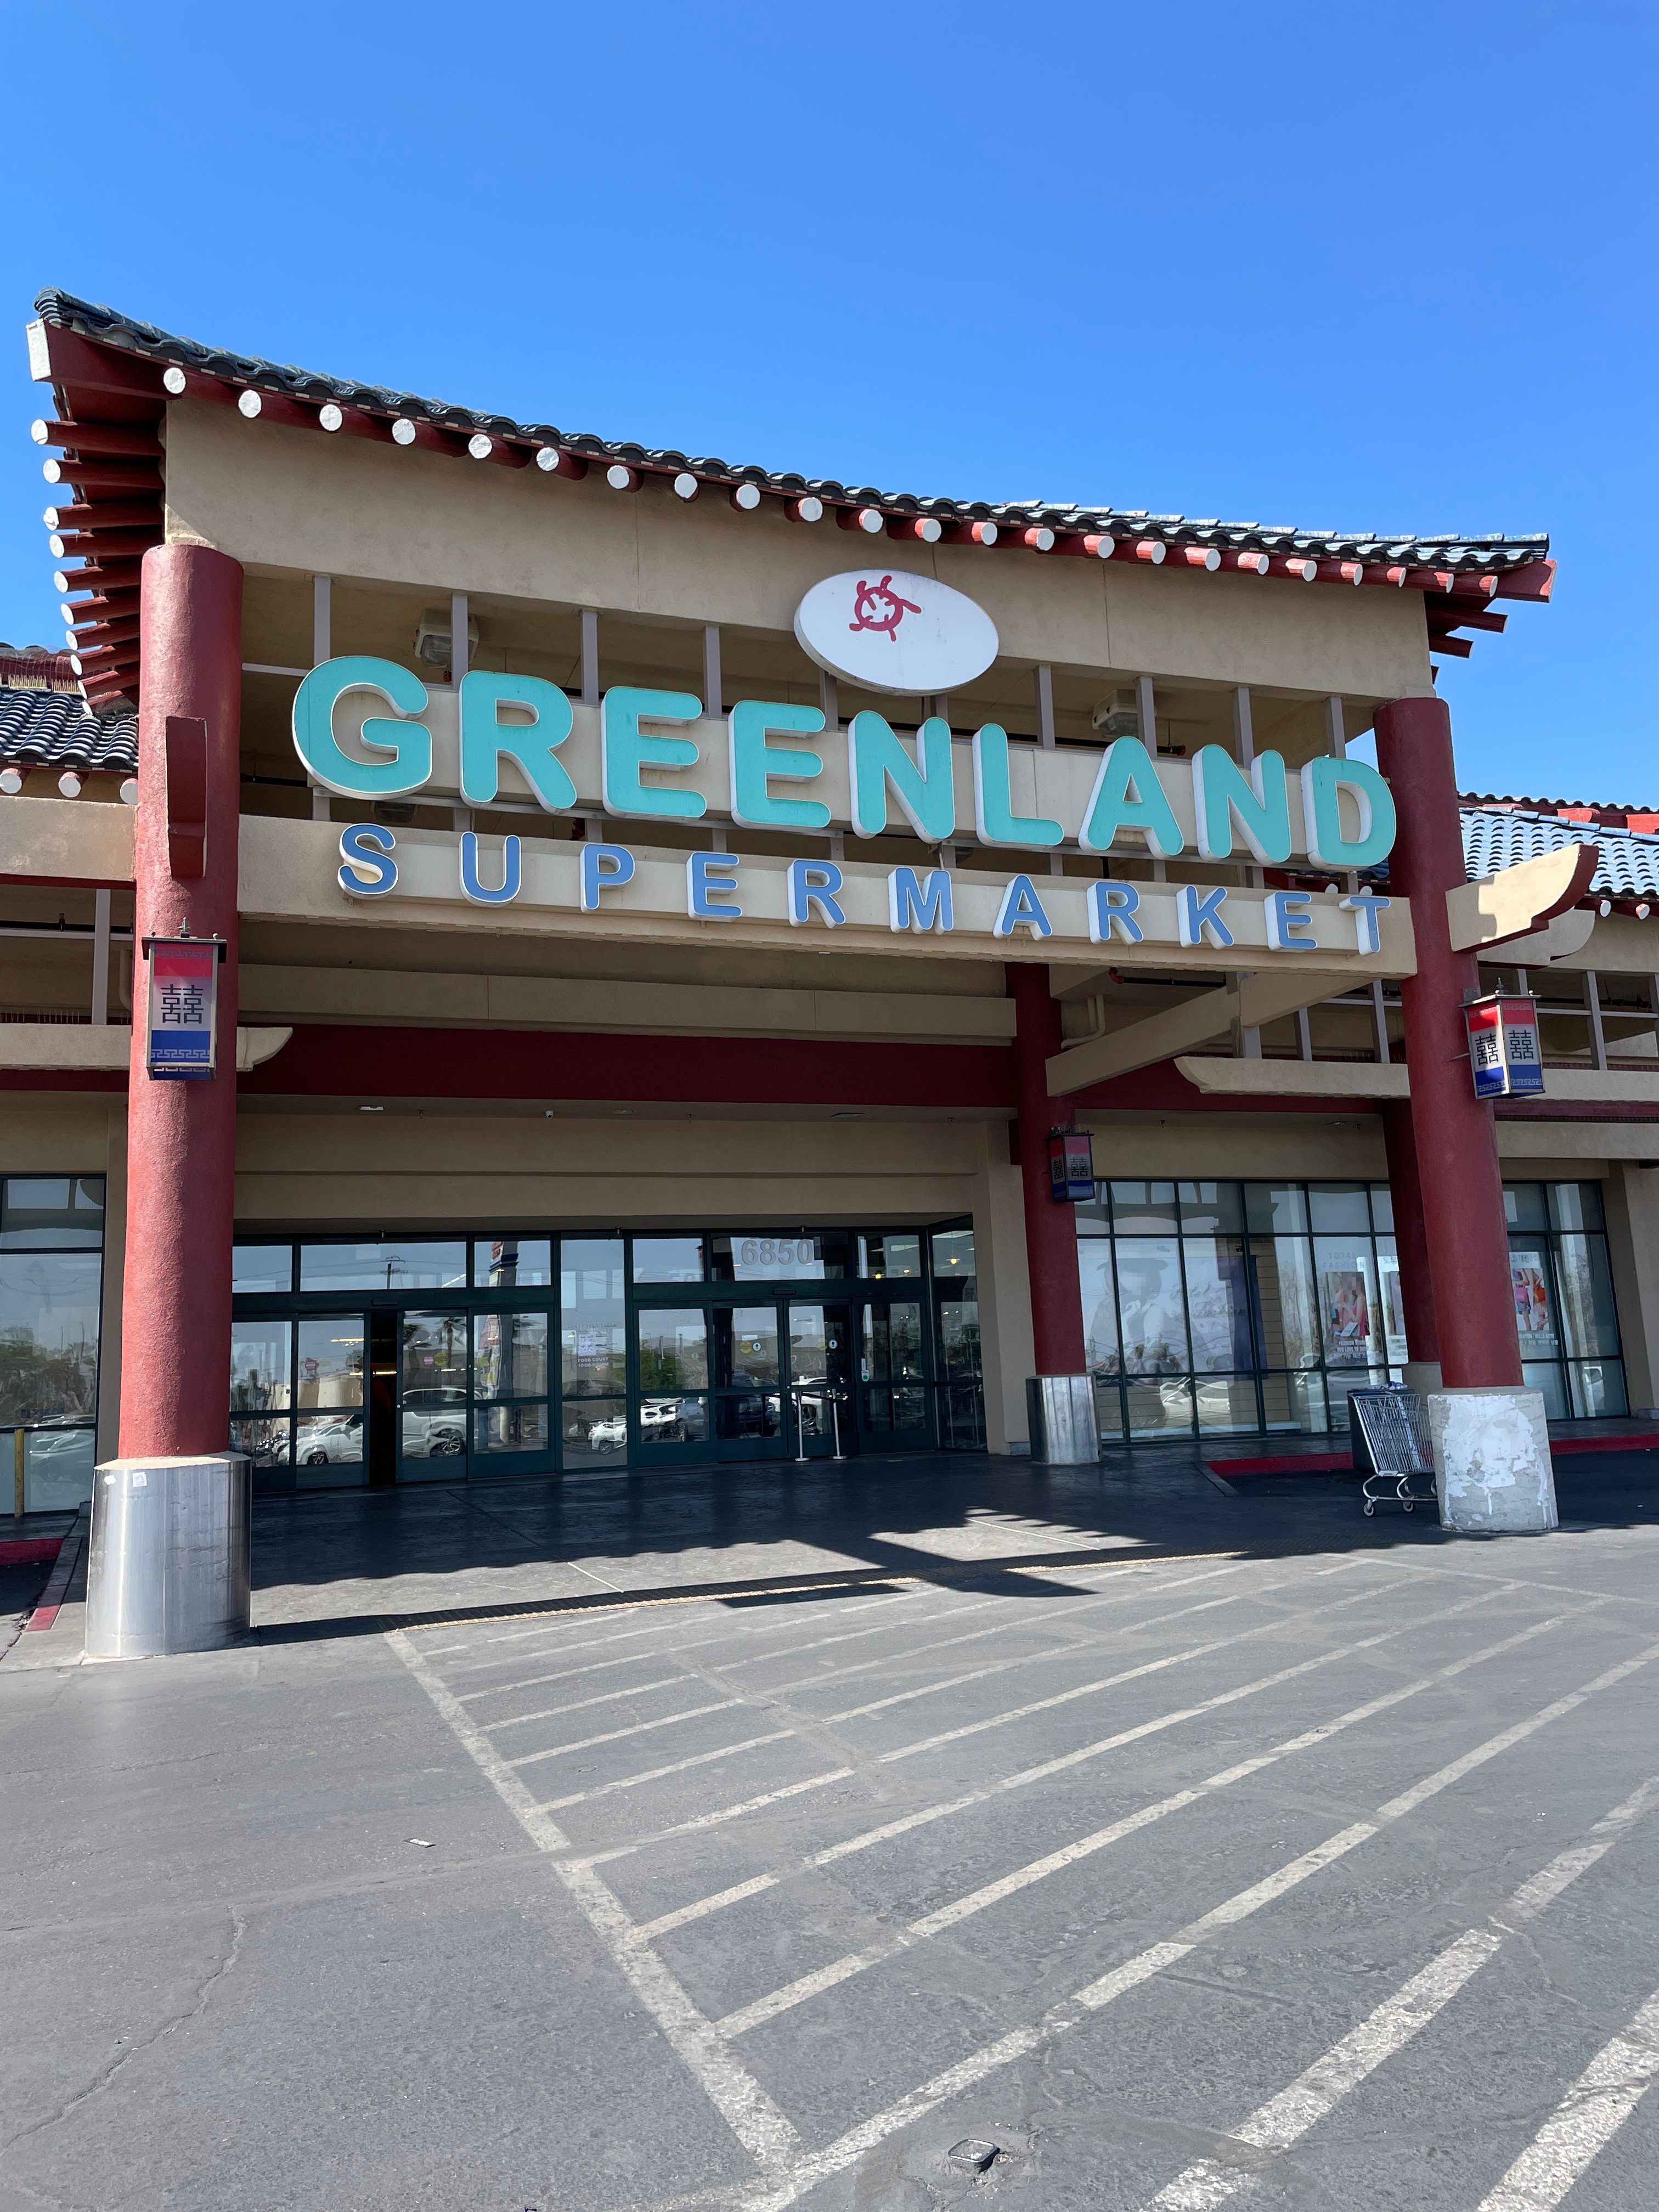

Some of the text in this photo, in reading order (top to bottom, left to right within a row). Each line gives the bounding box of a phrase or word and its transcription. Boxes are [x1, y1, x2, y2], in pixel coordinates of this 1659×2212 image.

[292, 656, 1397, 872] GREENLAND
[337, 823, 1391, 956] SUPERMARKET
[742, 1239, 814, 1265] 6850
